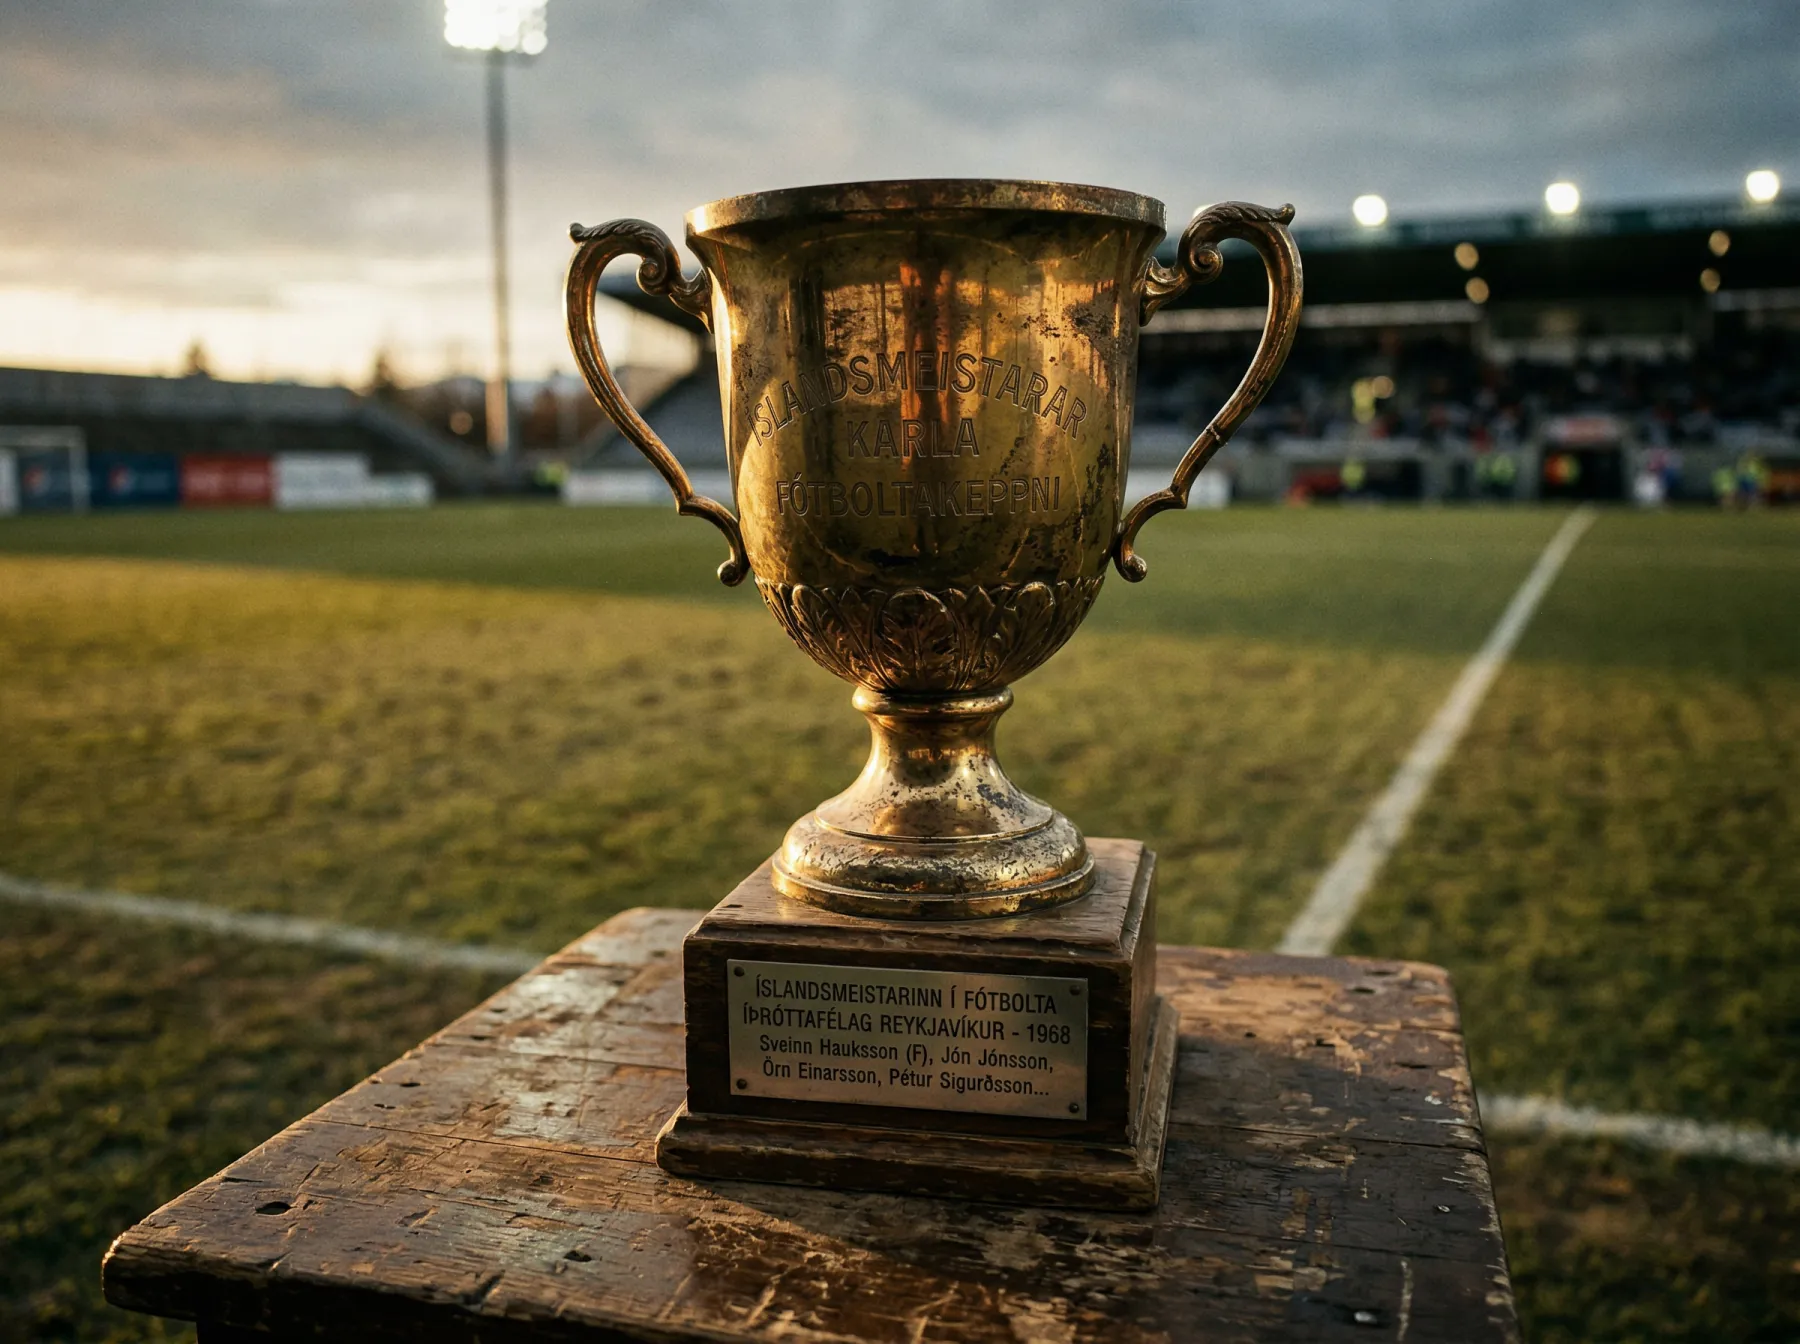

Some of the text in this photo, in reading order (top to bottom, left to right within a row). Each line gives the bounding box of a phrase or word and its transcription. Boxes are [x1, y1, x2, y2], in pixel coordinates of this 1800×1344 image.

[847, 418, 980, 458] KARLA
[776, 472, 1060, 517] FÓTBOLTAKEPPNI
[756, 975, 1057, 1014] ÍSLANDSMEISTARINN Í FÓTBOLTA
[743, 1006, 872, 1033] ÍÞRÓTTAFÉLAG
[880, 1015, 1004, 1041] REYKJAVÍKUR
[1027, 1024, 1070, 1045] 1968
[760, 1035, 1054, 1073] Sveinn Hauksson (F), Jón Jónsson,
[763, 1056, 1049, 1096] Örn Einarsson, Pétur Sigurðsson...
